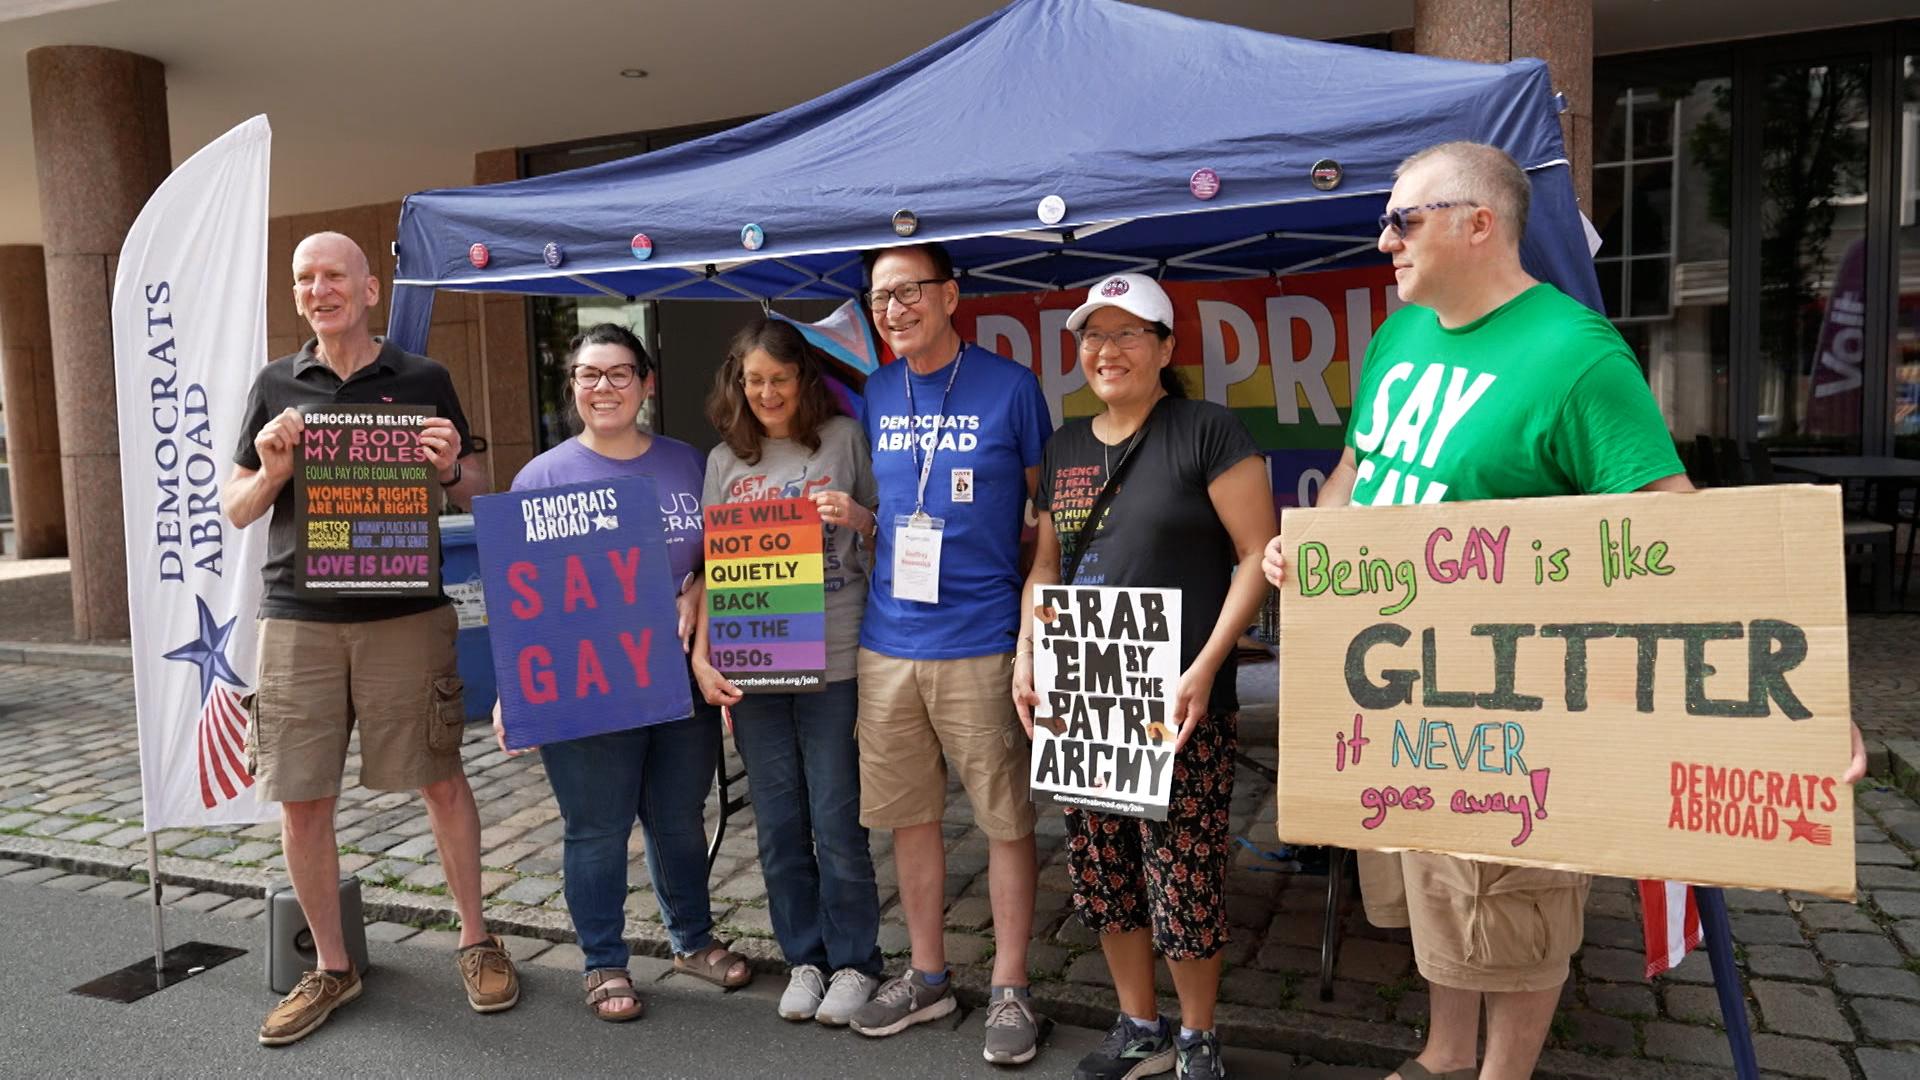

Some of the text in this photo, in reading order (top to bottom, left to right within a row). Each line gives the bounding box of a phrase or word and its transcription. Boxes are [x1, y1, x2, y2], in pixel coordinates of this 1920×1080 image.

[1198, 288, 1372, 426] PRI
[304, 413, 373, 425] DEMOCRATS
[880, 415, 980, 430] DEMOCRATS
[1355, 362, 1497, 469] SAY
[144, 280, 186, 583] DEMOCRATS
[305, 429, 423, 446] MY BODY
[878, 433, 977, 452] ABROAD
[305, 447, 426, 462] MY RULES
[184, 383, 224, 577] ABROAD
[306, 466, 427, 480] EQUAL PAY FOR EQUAL WORK
[1056, 465, 1101, 478] SCIENCE
[1066, 478, 1092, 487] REAL
[307, 486, 427, 500] WOMEN'S RIGHTS
[731, 474, 767, 496] GET
[307, 501, 428, 514] ARE HUMAN RIGHTS
[521, 488, 617, 522] DEMOCRATS
[660, 493, 699, 514] UD
[709, 503, 803, 526] WE WILL
[1051, 498, 1094, 511] MATTER
[526, 514, 590, 542] ABROAD
[662, 515, 703, 531] RAT
[709, 533, 791, 555] NOT GO
[306, 555, 428, 576] LOVE IS LOVE
[711, 561, 799, 582] QUIETLY
[1298, 518, 1676, 616] Being GAY is like
[507, 547, 641, 620] SAY
[712, 592, 770, 610] BACK
[1042, 589, 1170, 642] GRAB
[714, 619, 789, 640] TO THE
[518, 628, 653, 704] GAY
[714, 649, 773, 667] 1950s
[1124, 645, 1155, 674] BY
[1344, 618, 1813, 721] GLITTER
[1126, 676, 1164, 698] THE
[1336, 713, 1529, 775] it NEVER
[1036, 739, 1172, 796] ARCHY
[1669, 761, 1839, 813] DEMOCRATS
[1360, 768, 1551, 848] goes away!
[1667, 800, 1781, 842] ABROAD
